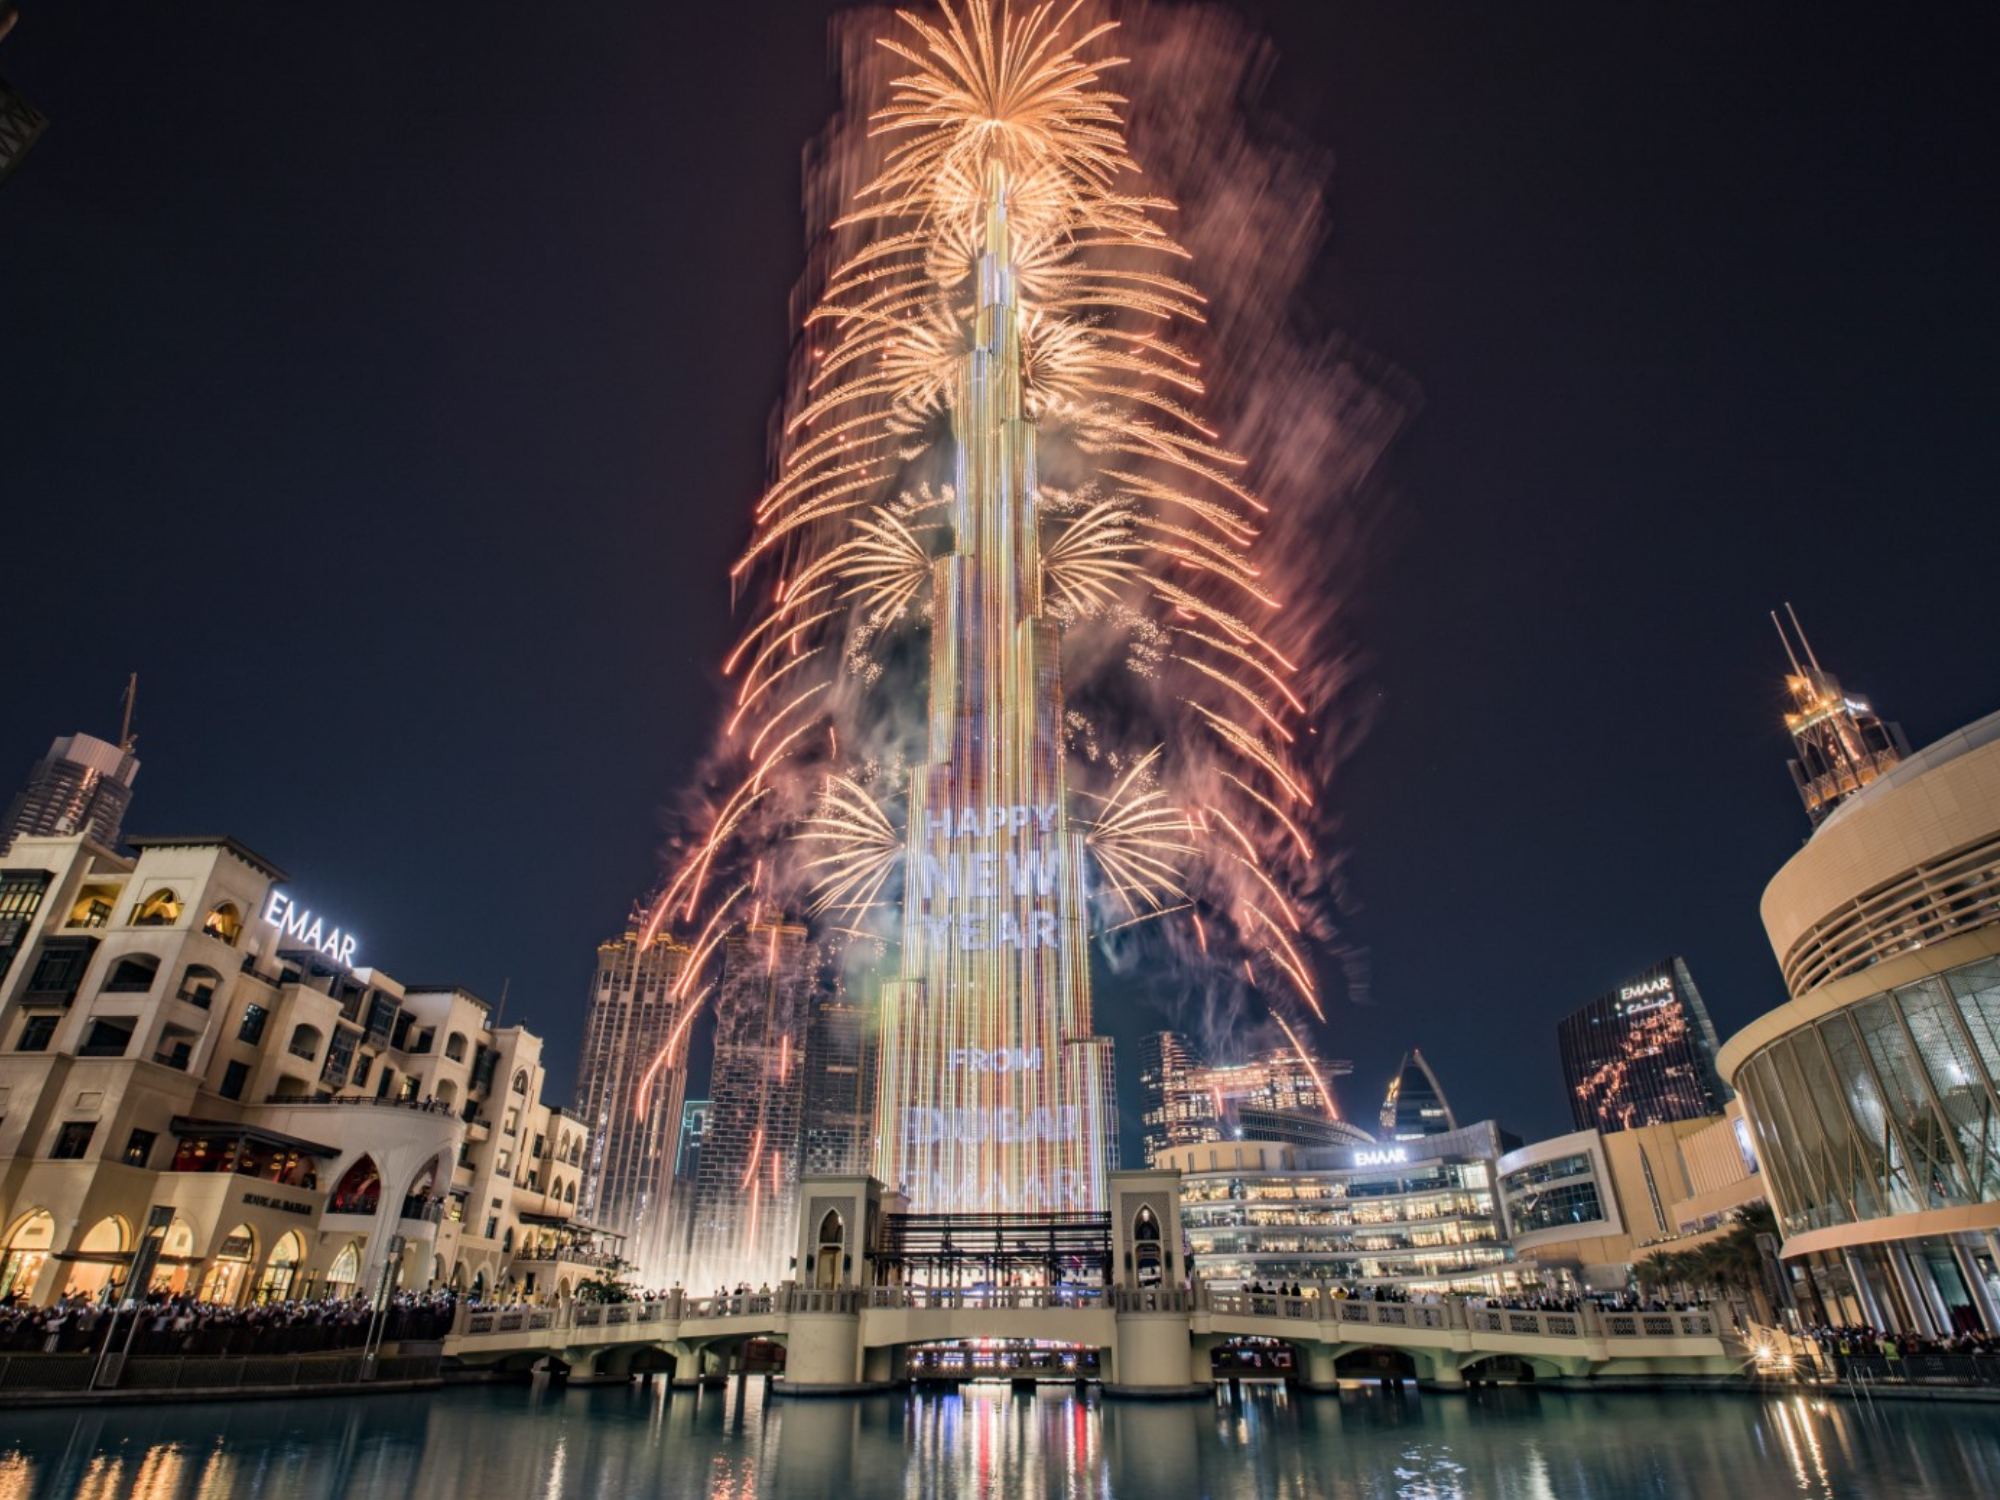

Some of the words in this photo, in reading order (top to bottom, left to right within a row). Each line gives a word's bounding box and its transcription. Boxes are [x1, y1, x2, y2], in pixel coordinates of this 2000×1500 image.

[925, 804, 1058, 840] HAPPY
[922, 849, 1060, 898] NEW
[264, 890, 356, 968] EMAAR
[924, 911, 1058, 950] YEAR
[1620, 977, 1671, 1000] EMAAR
[948, 1047, 1042, 1074] FROM
[1355, 1149, 1407, 1166] EMAAR
